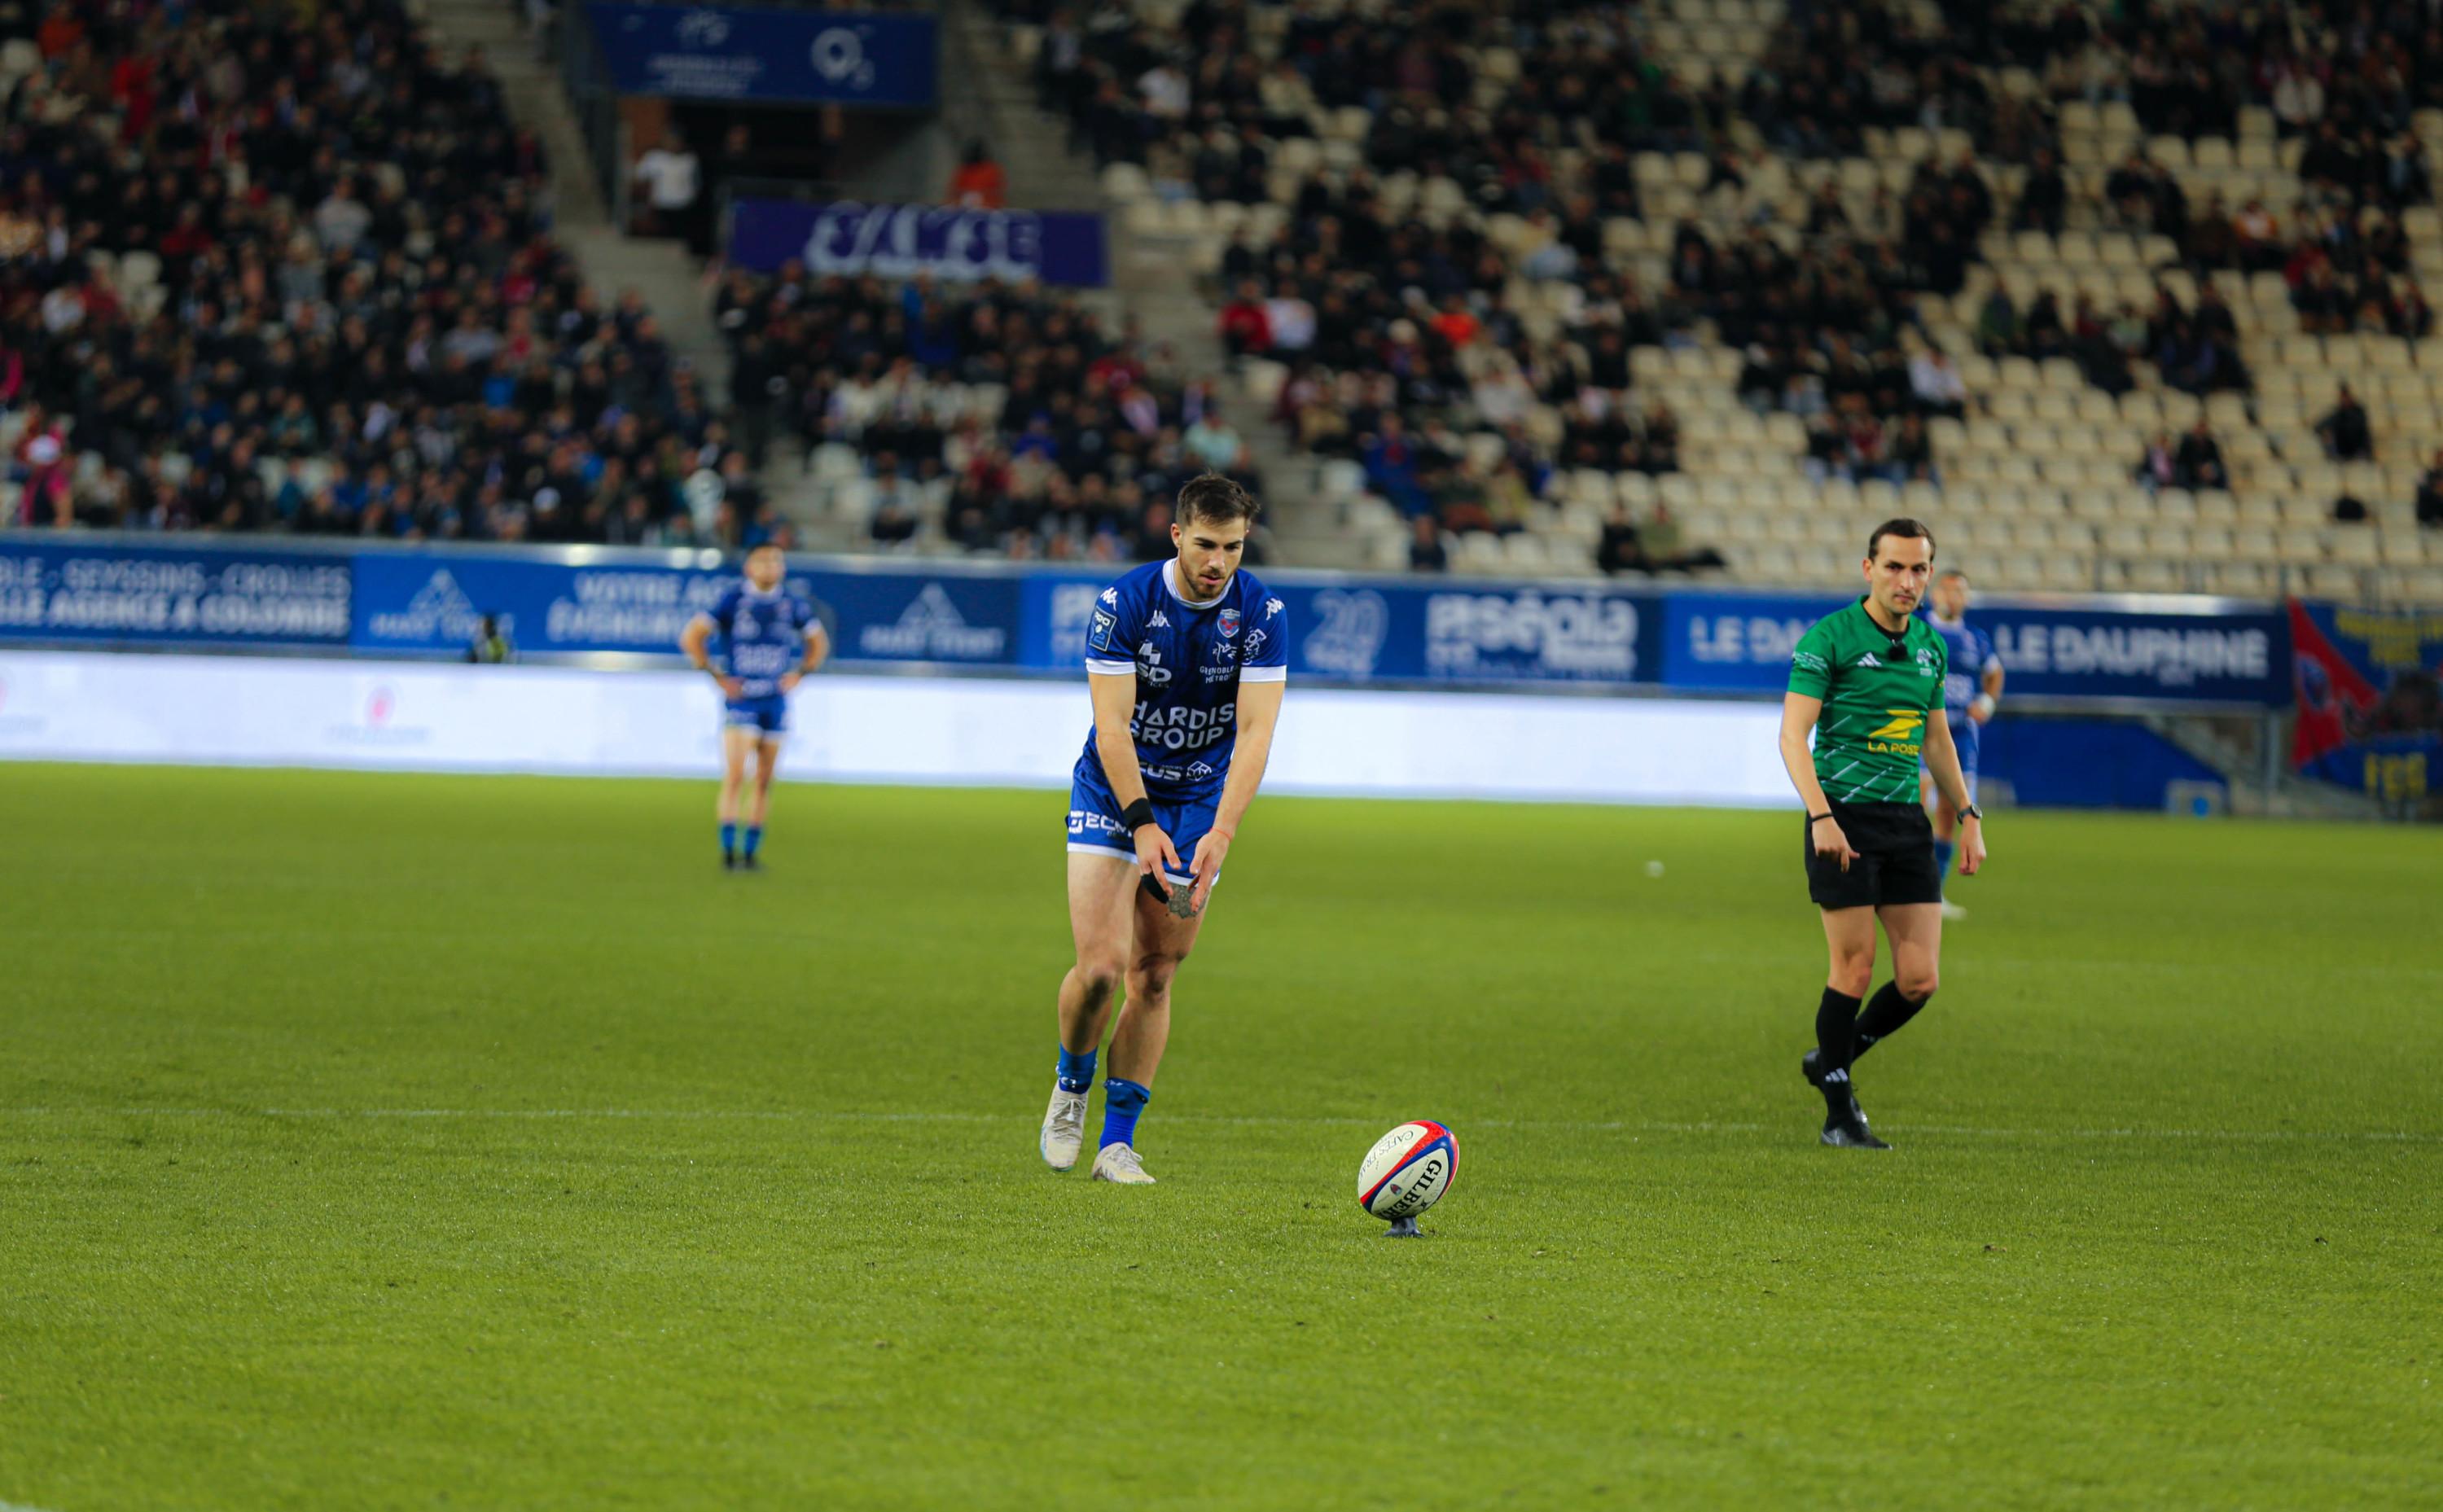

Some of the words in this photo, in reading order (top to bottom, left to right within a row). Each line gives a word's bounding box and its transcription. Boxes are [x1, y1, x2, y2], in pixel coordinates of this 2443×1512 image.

[1688, 615, 1743, 663] LE
[1996, 624, 2049, 673] LE
[1867, 741, 1889, 754] LA
